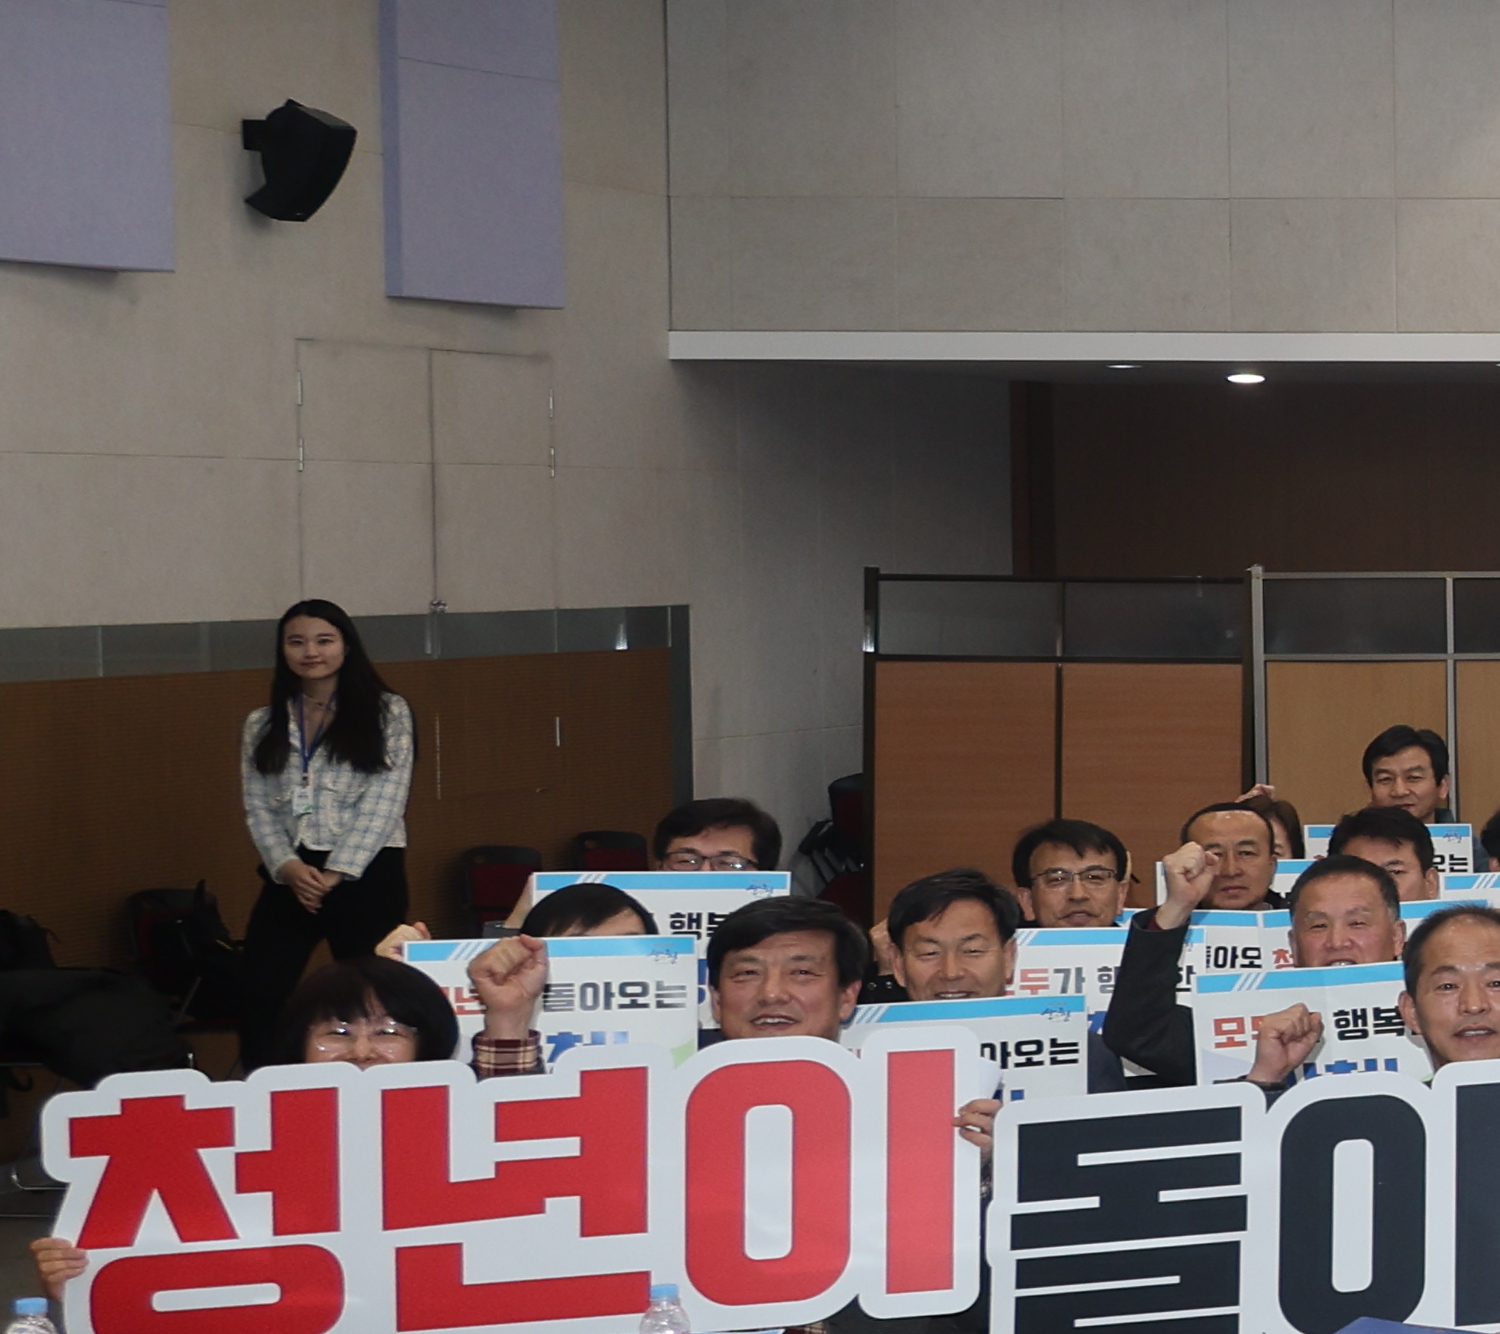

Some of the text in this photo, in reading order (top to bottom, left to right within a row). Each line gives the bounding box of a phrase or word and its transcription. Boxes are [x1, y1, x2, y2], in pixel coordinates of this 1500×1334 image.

[543, 978, 687, 1011] 돌아오는
[1333, 1005, 1404, 1040] 행복
[981, 1037, 1080, 1069] 아오는
